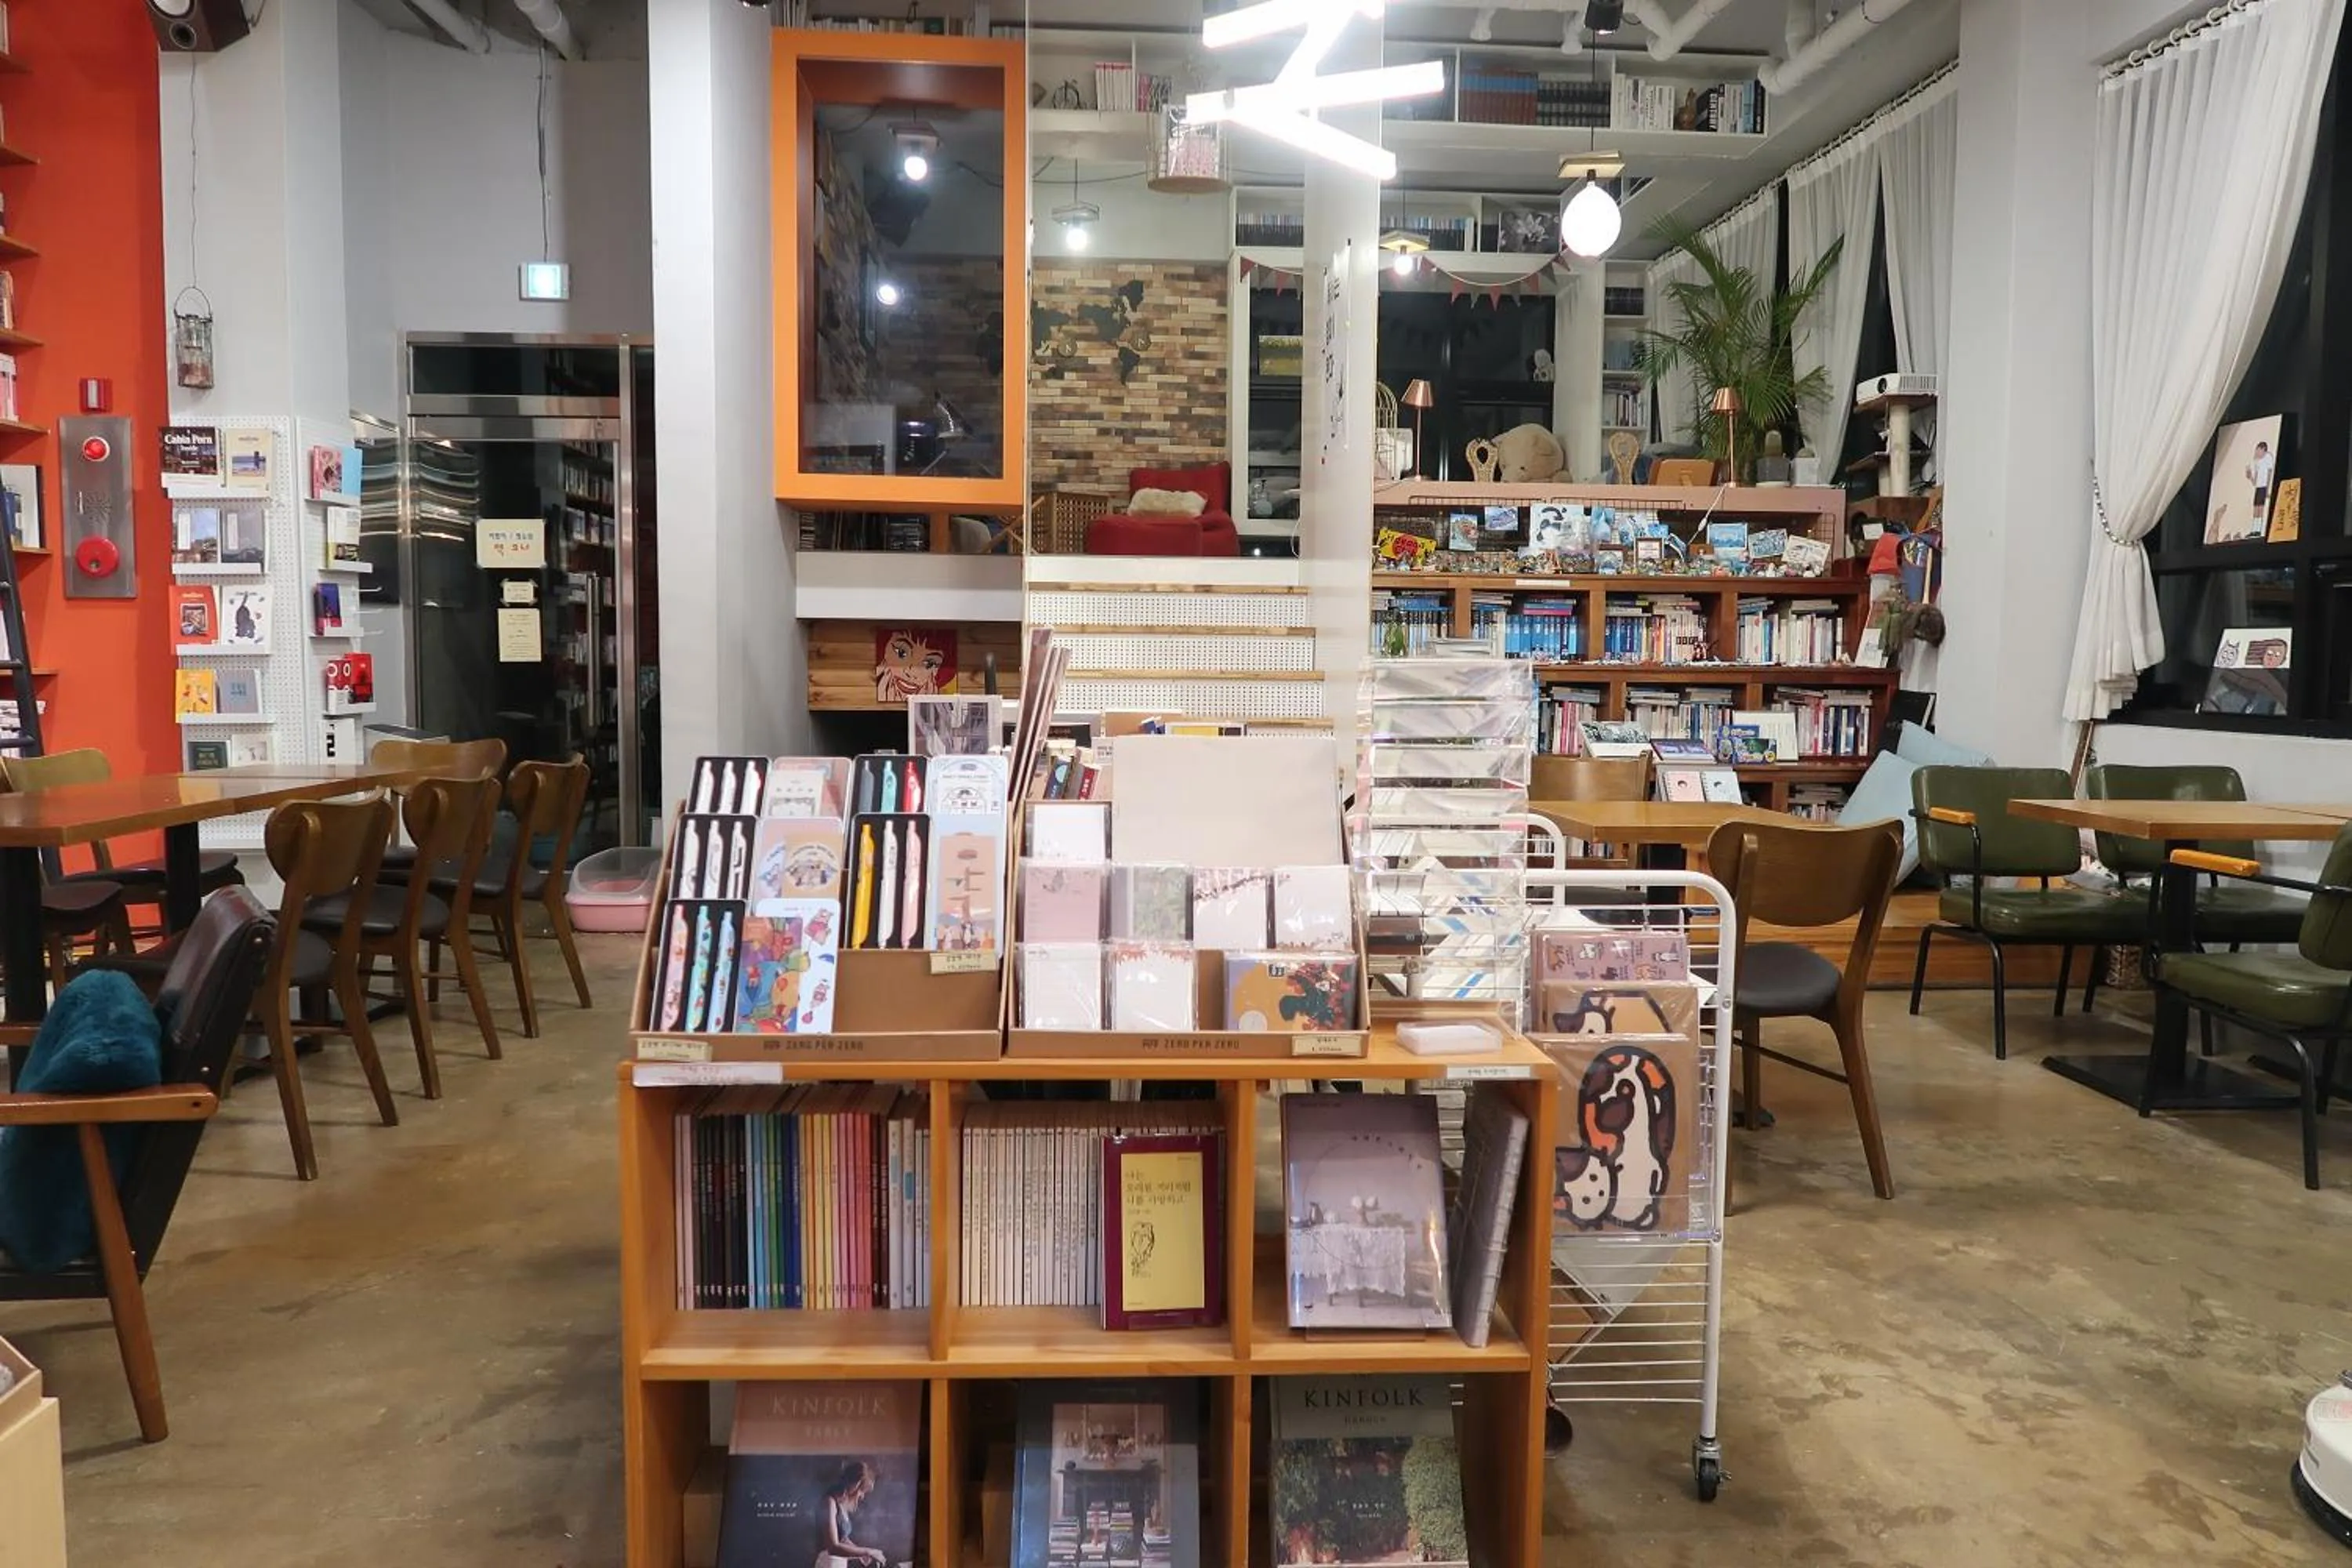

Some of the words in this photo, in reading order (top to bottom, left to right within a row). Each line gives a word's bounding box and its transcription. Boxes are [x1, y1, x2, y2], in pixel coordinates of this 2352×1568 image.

[165, 434, 190, 445] Cabin
[191, 434, 213, 445] Porn
[772, 1393, 886, 1417] KINFOLK
[1305, 1388, 1424, 1408] KINFOLK
